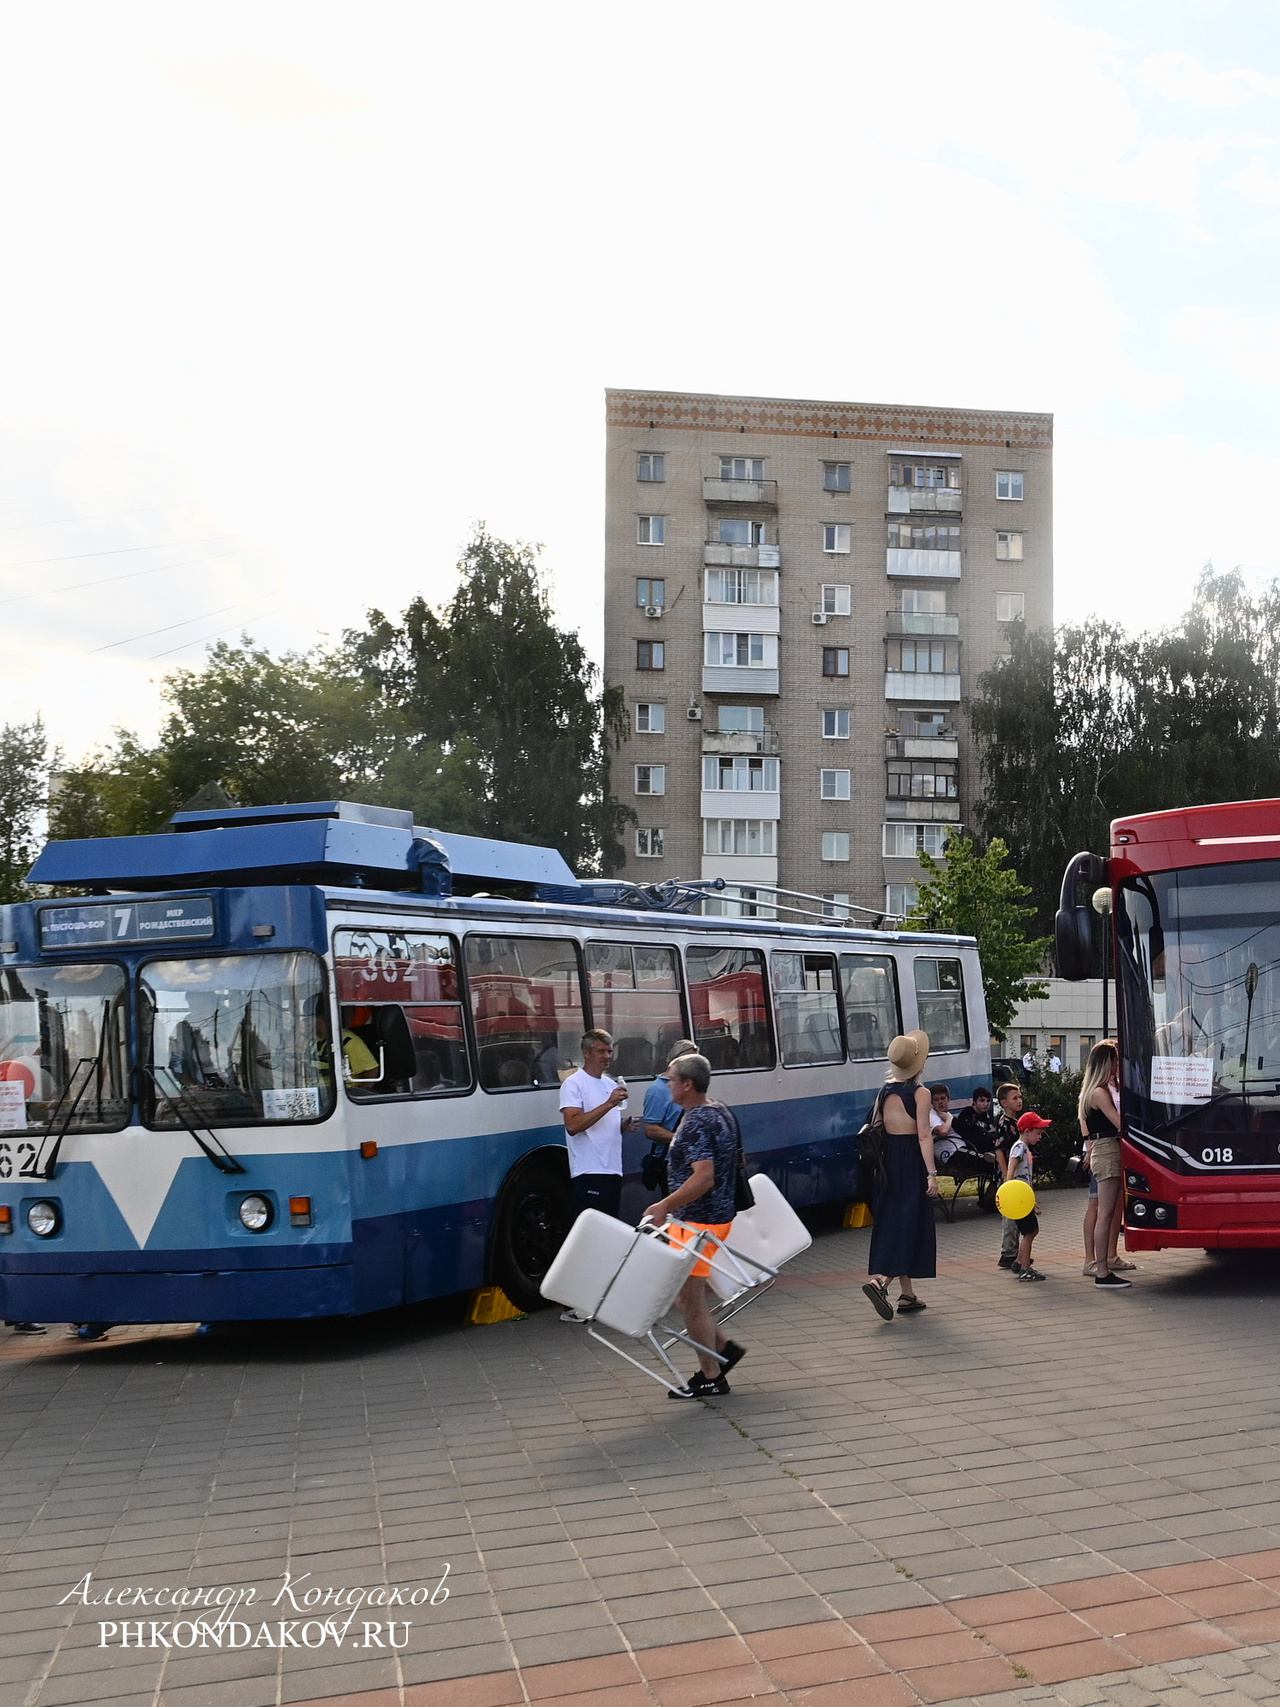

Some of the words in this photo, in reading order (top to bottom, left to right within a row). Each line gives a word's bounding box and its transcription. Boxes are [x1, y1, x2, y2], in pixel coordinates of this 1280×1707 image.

[166, 909, 184, 918] МКР
[51, 920, 105, 932] ПУСТОШЬ-БОР
[114, 908, 132, 937] 7
[139, 916, 213, 930] РОЖДЕСТВЕНСКИЙ
[1201, 1147, 1233, 1163] 018
